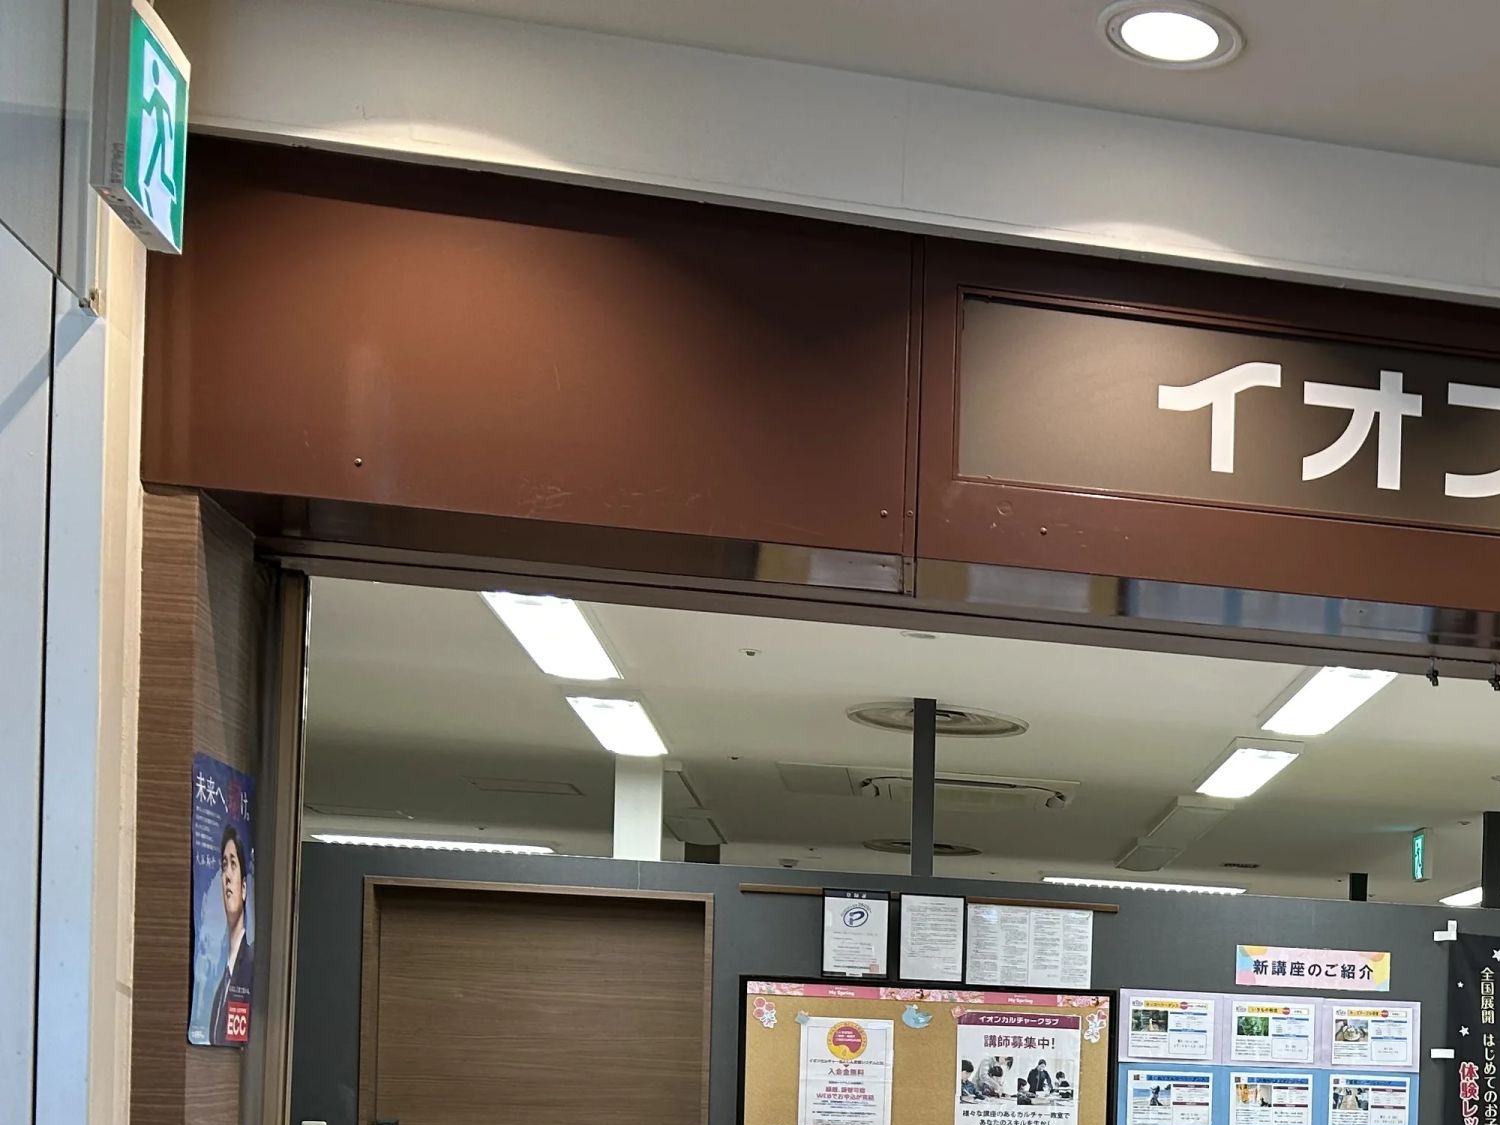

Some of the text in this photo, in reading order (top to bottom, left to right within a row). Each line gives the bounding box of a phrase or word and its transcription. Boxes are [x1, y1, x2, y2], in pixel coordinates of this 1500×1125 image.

[1252, 959, 1374, 981] 新講座のご紹介
[1480, 967, 1496, 1024] 全国展開
[227, 1014, 247, 1036] ECC
[978, 1016, 1060, 1026] イオンカルチャークラブ
[984, 1034, 1056, 1050] 講師募集中!
[962, 1110, 1070, 1120] 様々な講座のあるカルチャー教室で
